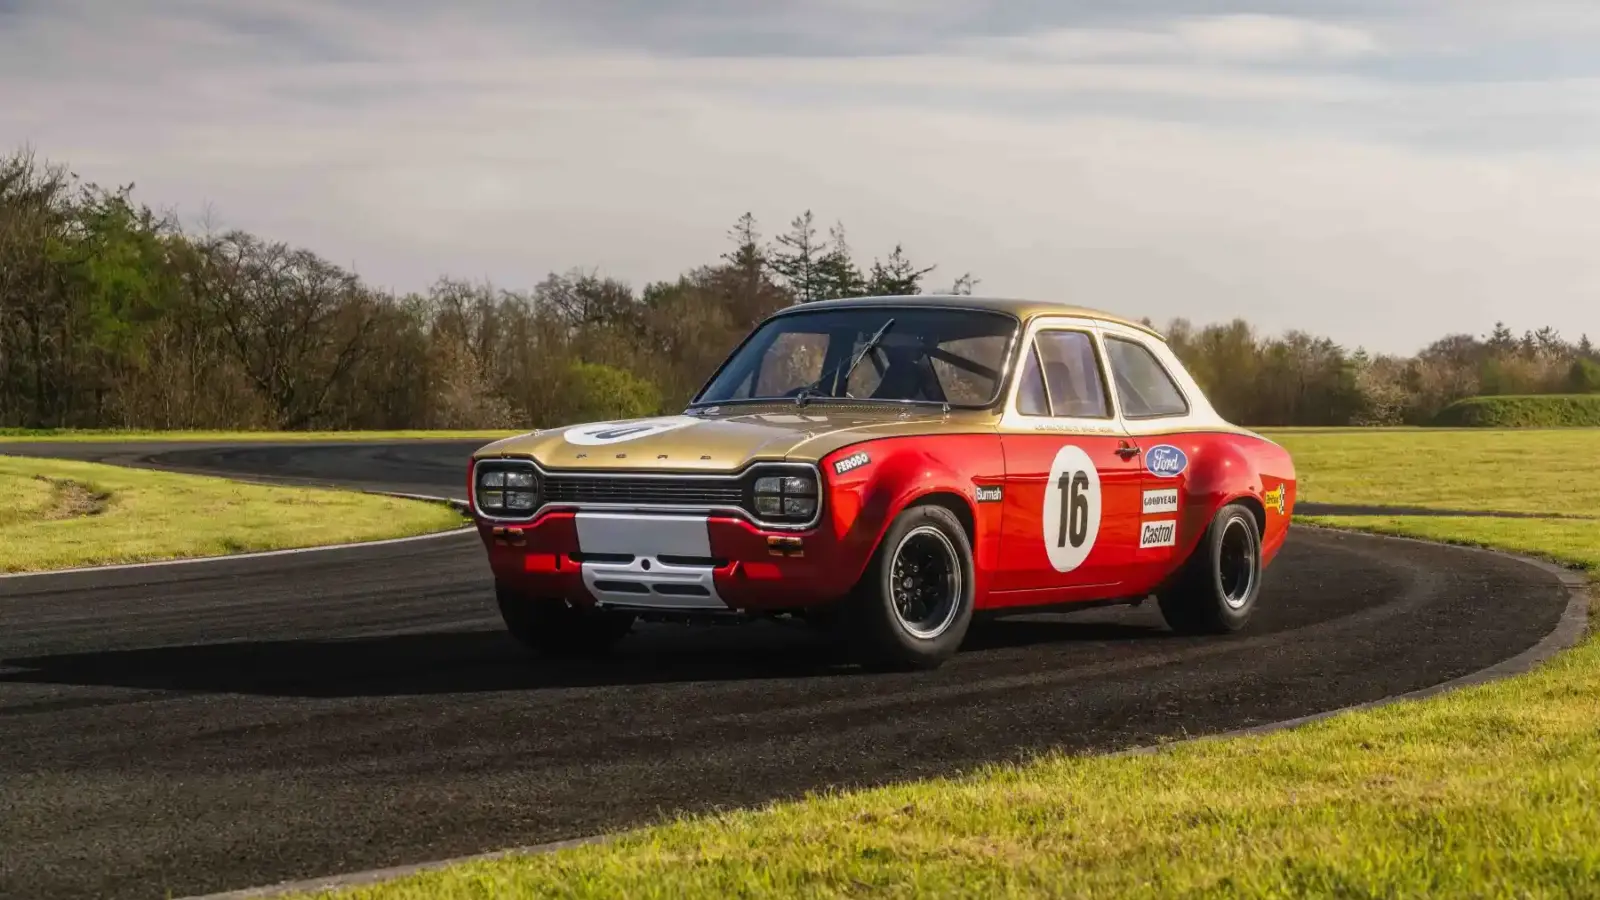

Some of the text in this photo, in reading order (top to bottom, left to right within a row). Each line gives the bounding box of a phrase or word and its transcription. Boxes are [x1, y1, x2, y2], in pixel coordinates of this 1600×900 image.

[835, 452, 868, 473] FERODO
[1153, 448, 1179, 471] Ford
[976, 487, 1001, 500] Burmah
[1144, 495, 1177, 506] GOODYEAR
[1057, 470, 1089, 547] 16
[1142, 523, 1174, 545] Castrol
